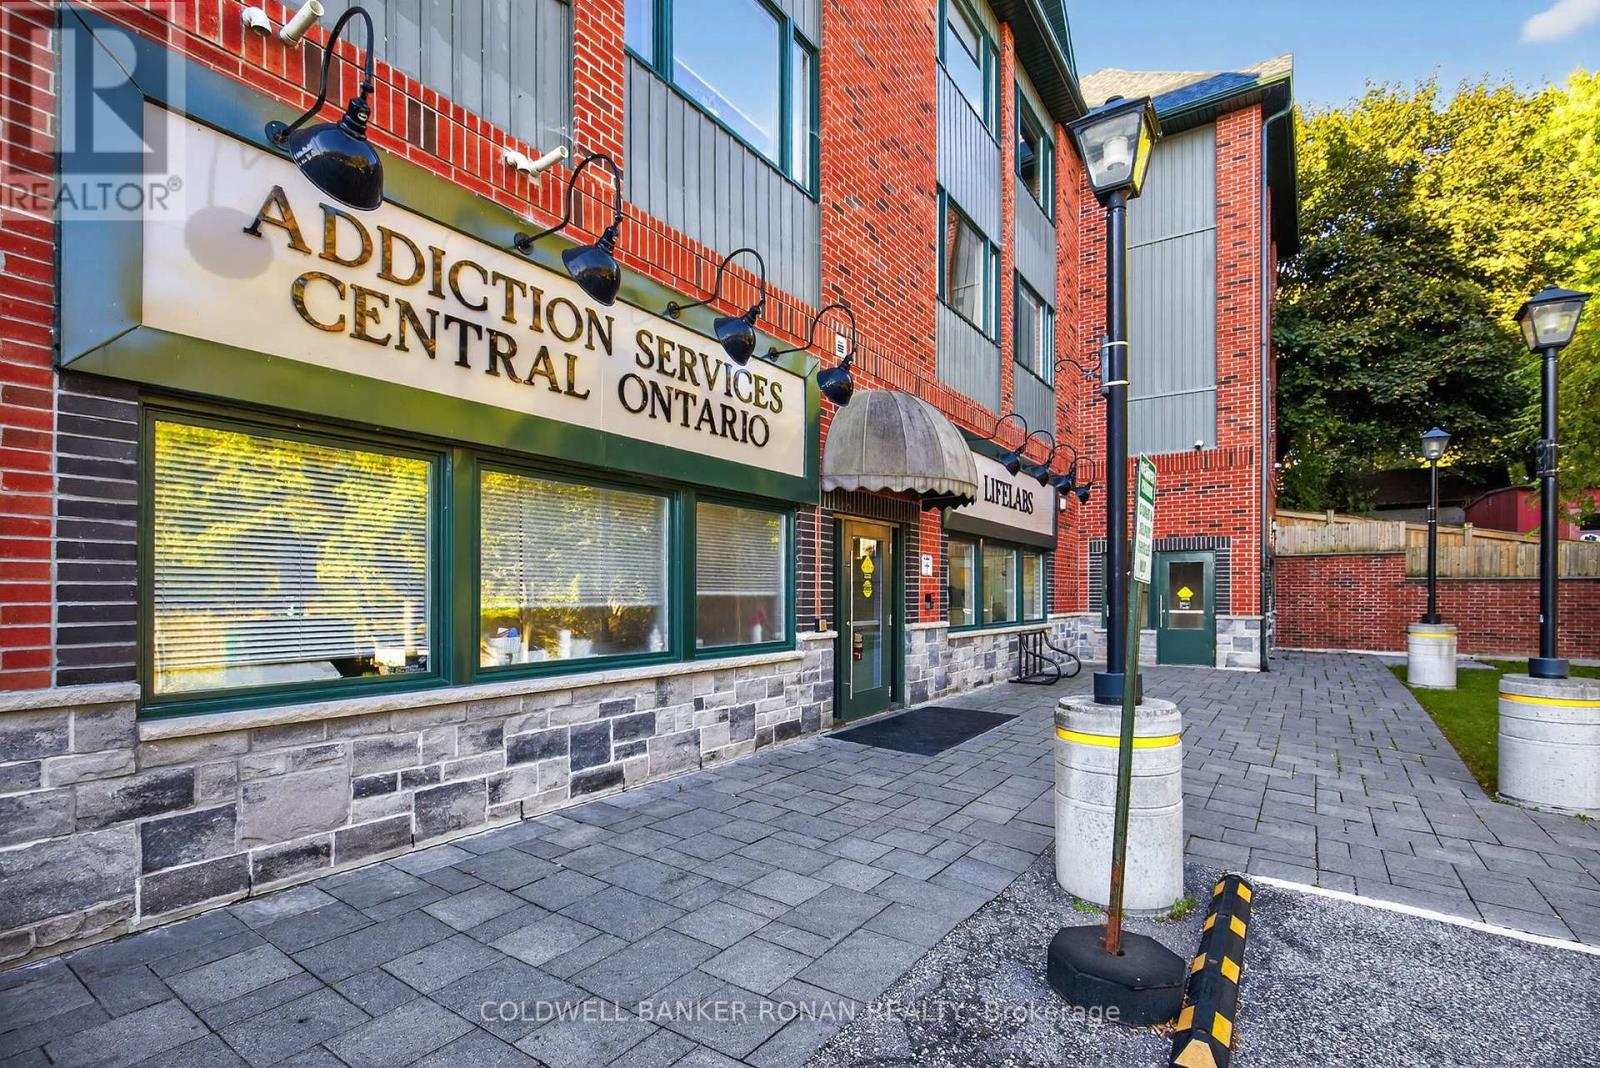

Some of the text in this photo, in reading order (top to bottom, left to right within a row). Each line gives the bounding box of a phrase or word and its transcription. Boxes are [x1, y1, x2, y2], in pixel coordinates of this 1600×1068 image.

[243, 185, 783, 414] ADDICTION SERVICES
[291, 270, 770, 447] CENTRAL ONTARIO
[984, 475, 1034, 515] LIFELABS
